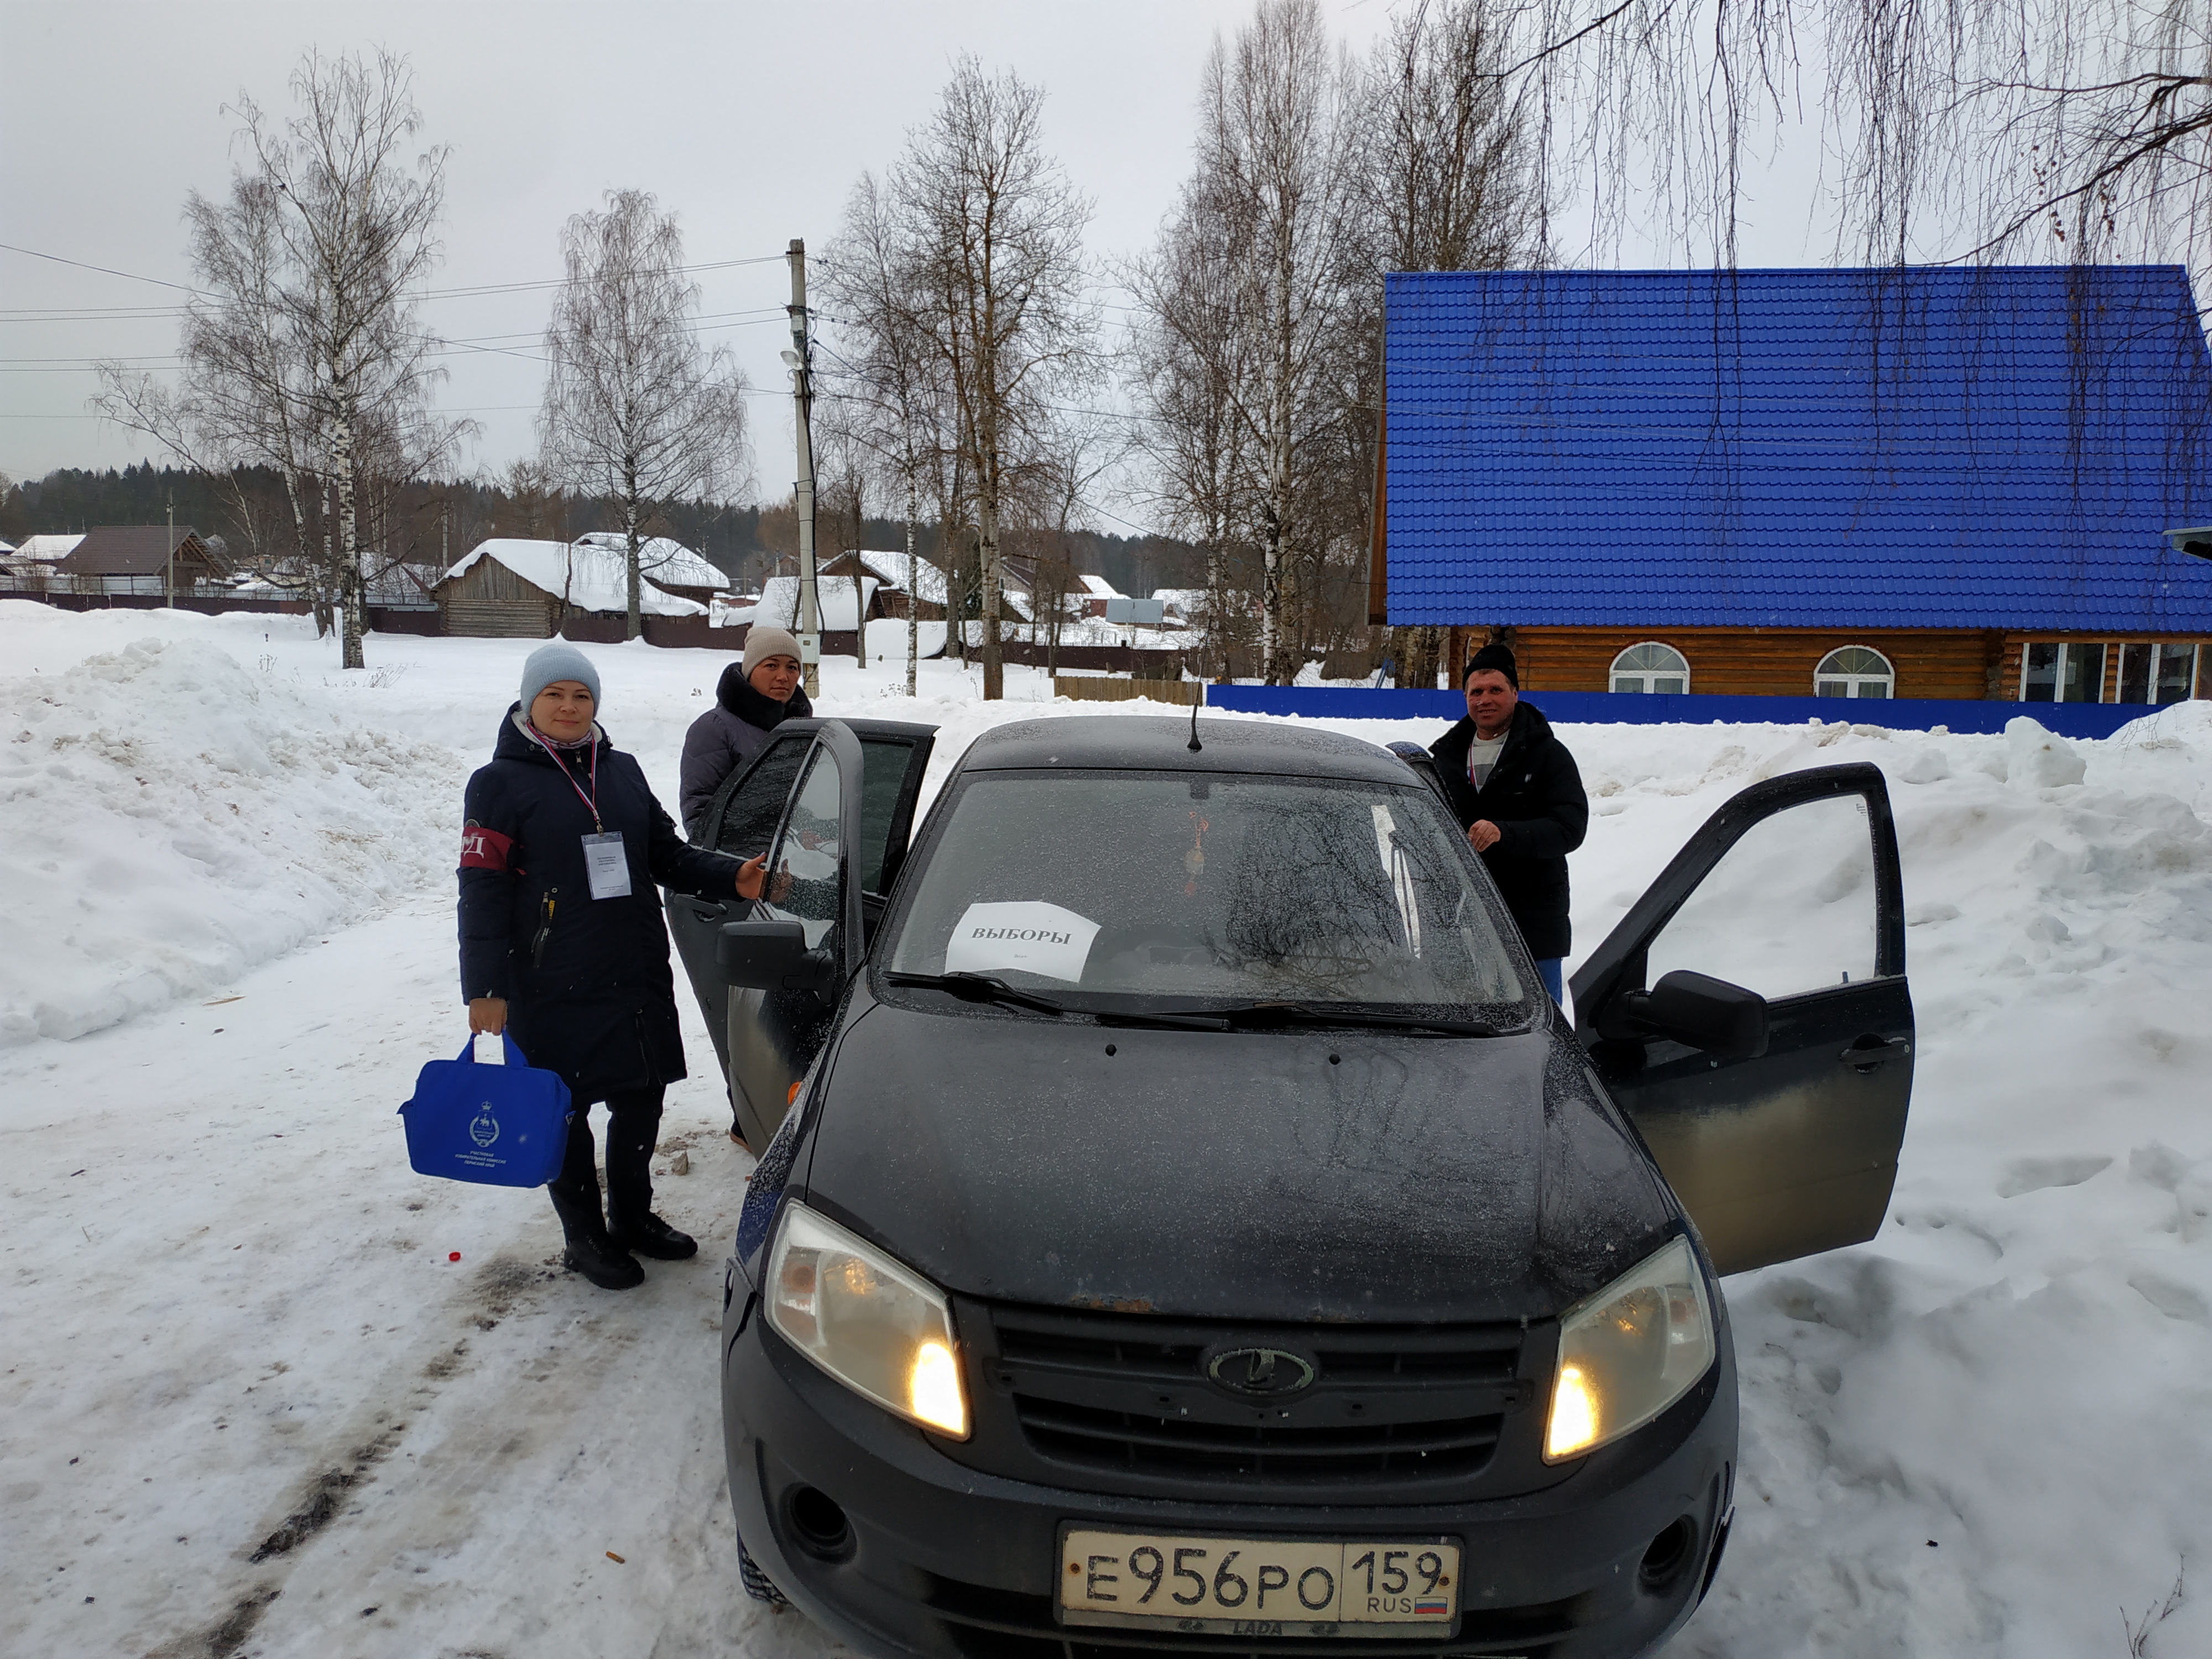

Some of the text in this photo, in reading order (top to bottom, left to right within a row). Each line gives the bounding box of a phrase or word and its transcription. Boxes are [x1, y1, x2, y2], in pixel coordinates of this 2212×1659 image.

[971, 928, 1072, 945] ВЫБОРЫ
[1352, 1551, 1442, 1595] 159
[1367, 1597, 1412, 1614] RUS
[1233, 1621, 1282, 1635] LADA
